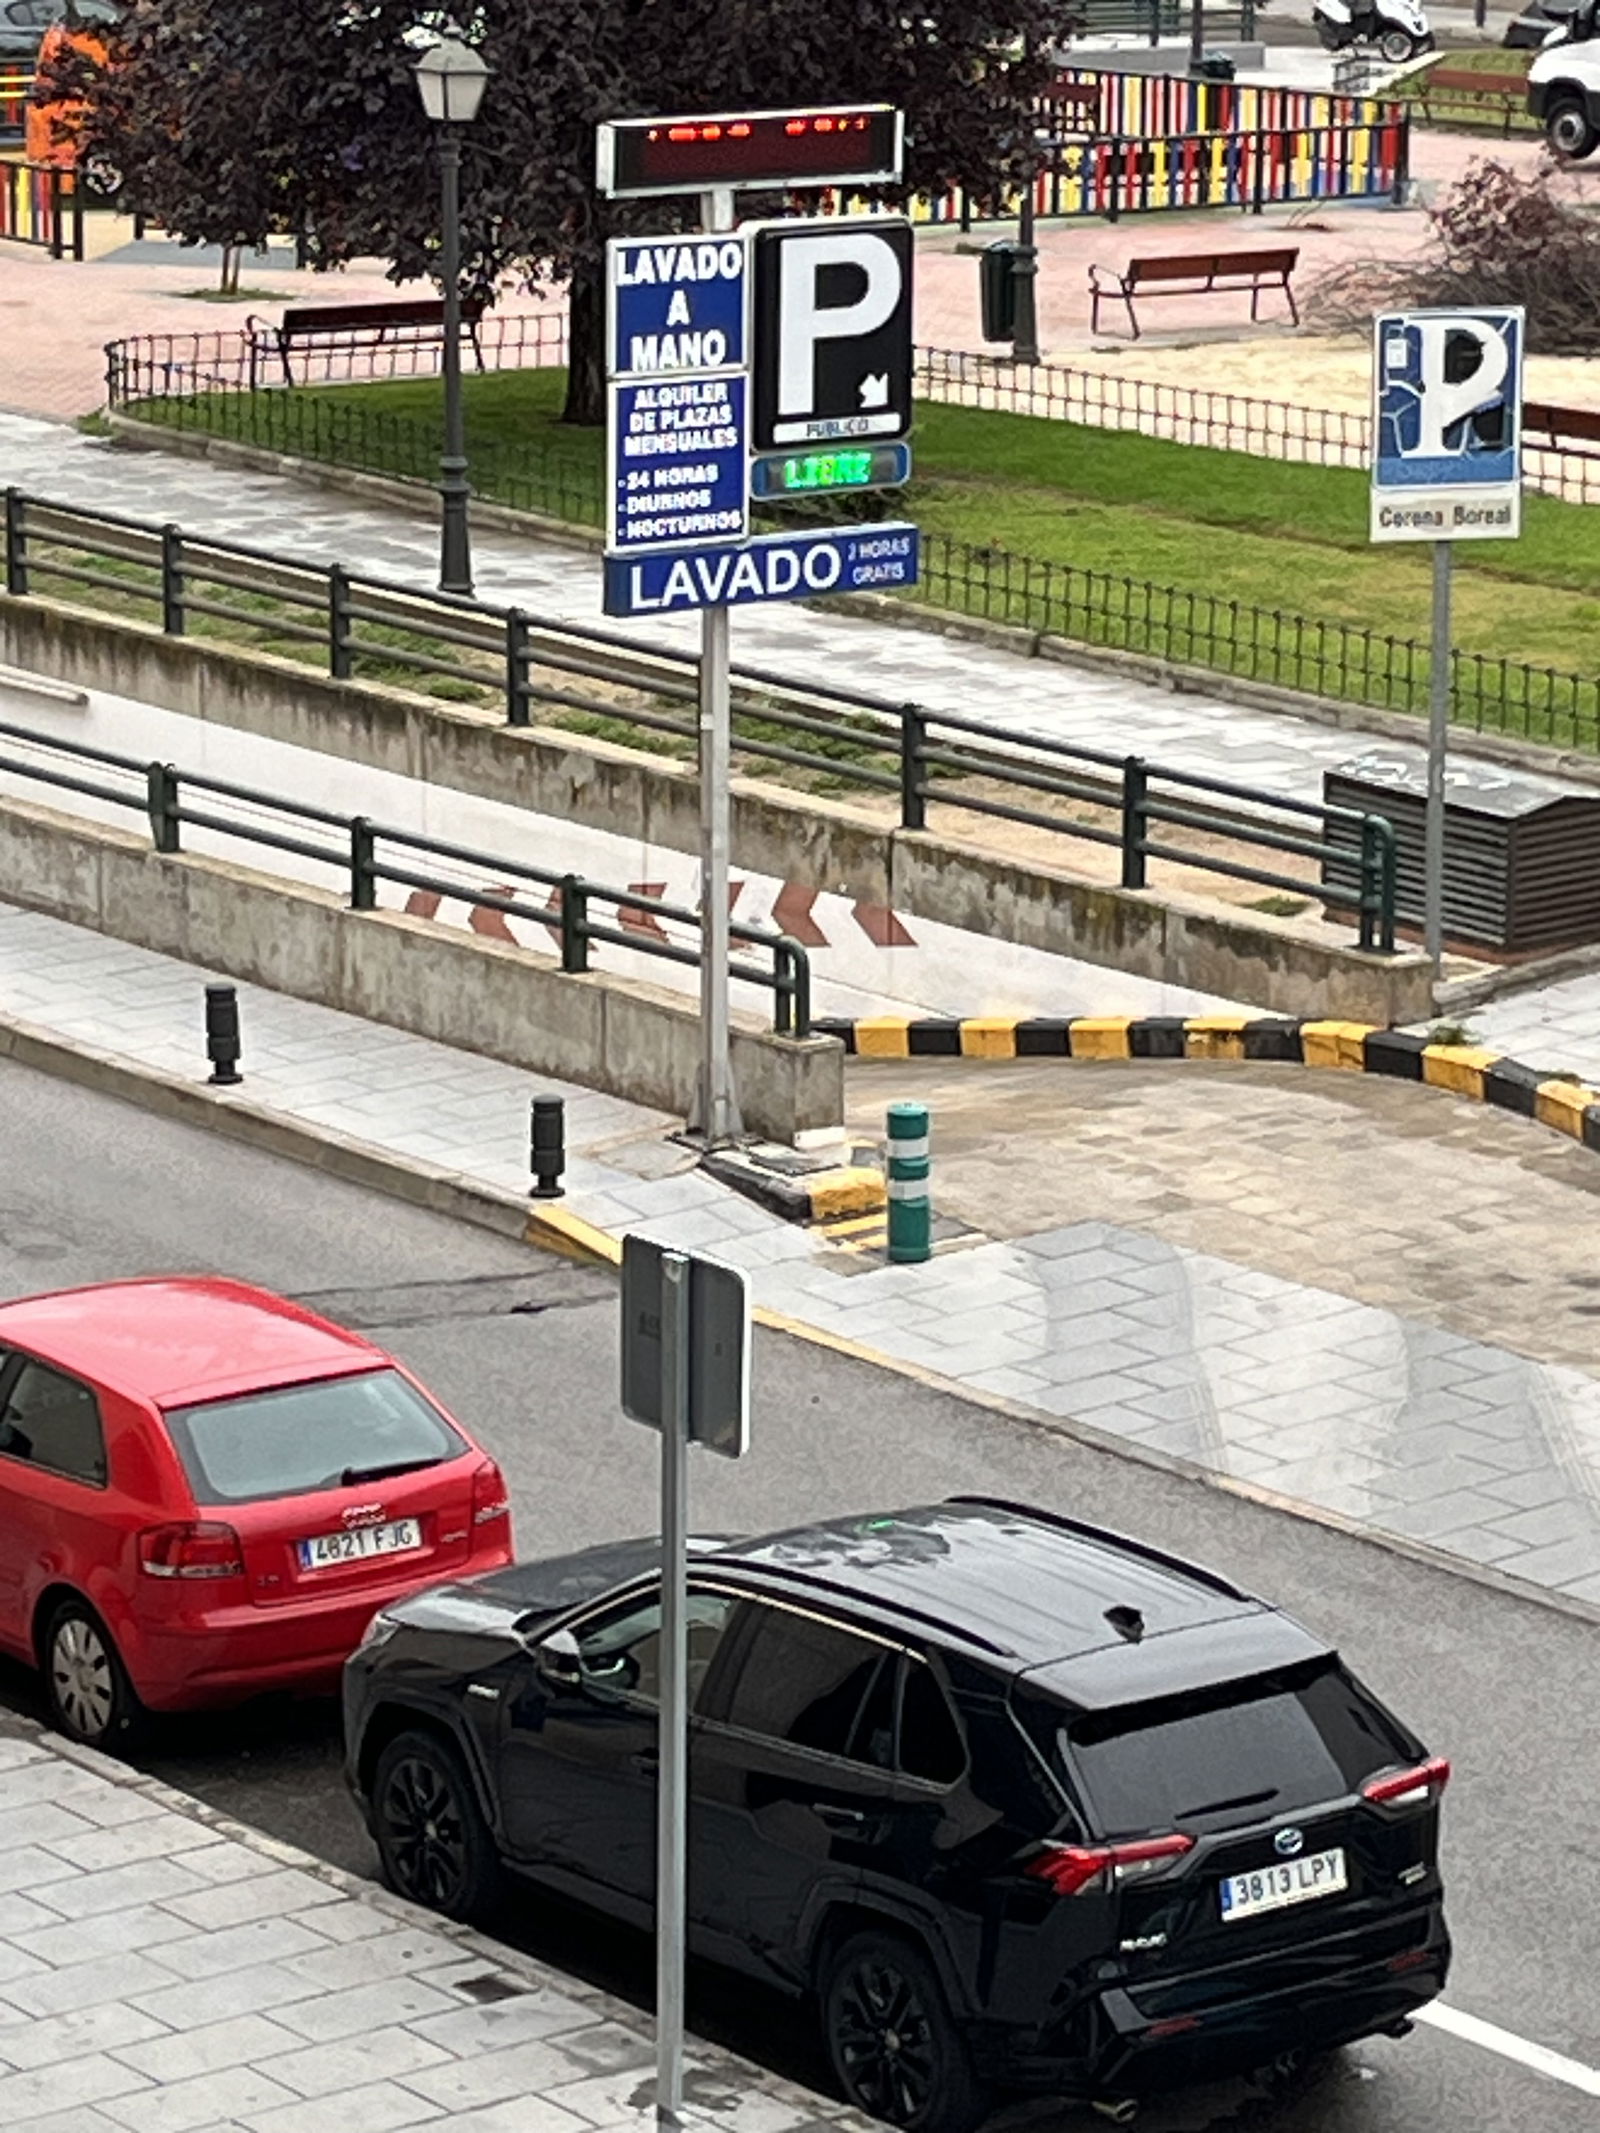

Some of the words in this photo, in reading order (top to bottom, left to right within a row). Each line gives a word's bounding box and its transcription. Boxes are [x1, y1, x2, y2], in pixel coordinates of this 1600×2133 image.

[616, 242, 743, 286] LAVADO
[665, 289, 691, 328] A
[778, 233, 902, 415] P
[631, 328, 727, 373] MANO
[634, 383, 728, 410] ALQUILER
[629, 412, 656, 432] DE
[660, 404, 733, 430] PLAZAS
[624, 426, 738, 456] MENSUALES
[653, 463, 719, 487] HORAS
[627, 489, 711, 514] DIURNOS
[627, 510, 742, 539] NOCTURNOS
[631, 544, 842, 609] LAVADO
[1236, 1867, 1292, 1905] 3813
[1298, 1853, 1339, 1889] LPY
